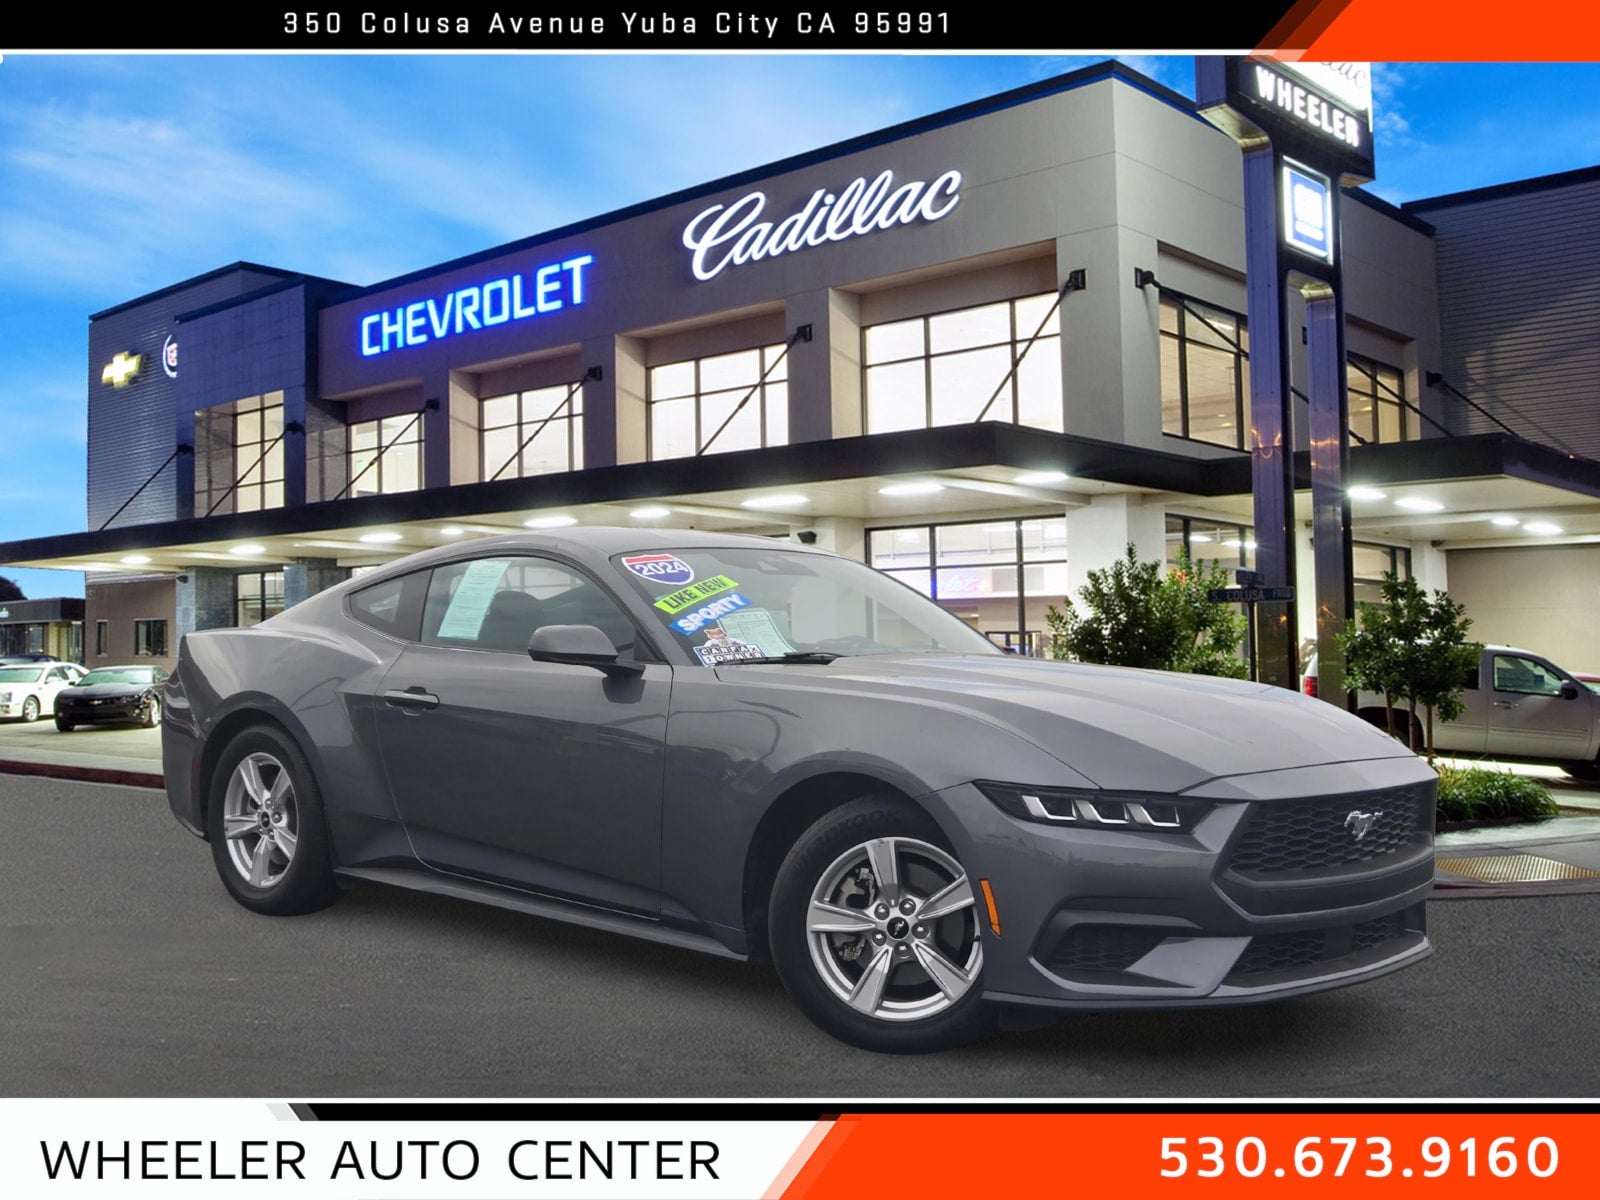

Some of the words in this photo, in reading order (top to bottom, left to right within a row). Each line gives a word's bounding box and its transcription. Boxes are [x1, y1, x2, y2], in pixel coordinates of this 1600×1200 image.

[1255, 65, 1360, 148] WHEELER
[682, 169, 963, 282] Cadillac
[360, 254, 594, 357] CHEVROLET
[634, 561, 689, 577] 2024
[662, 588, 698, 610] LIKE
[694, 576, 729, 595] NEW
[1226, 589, 1265, 601] COLUSA
[677, 593, 746, 632] SPORTY
[700, 644, 761, 656] CARFAX
[715, 652, 763, 662] OWNER
